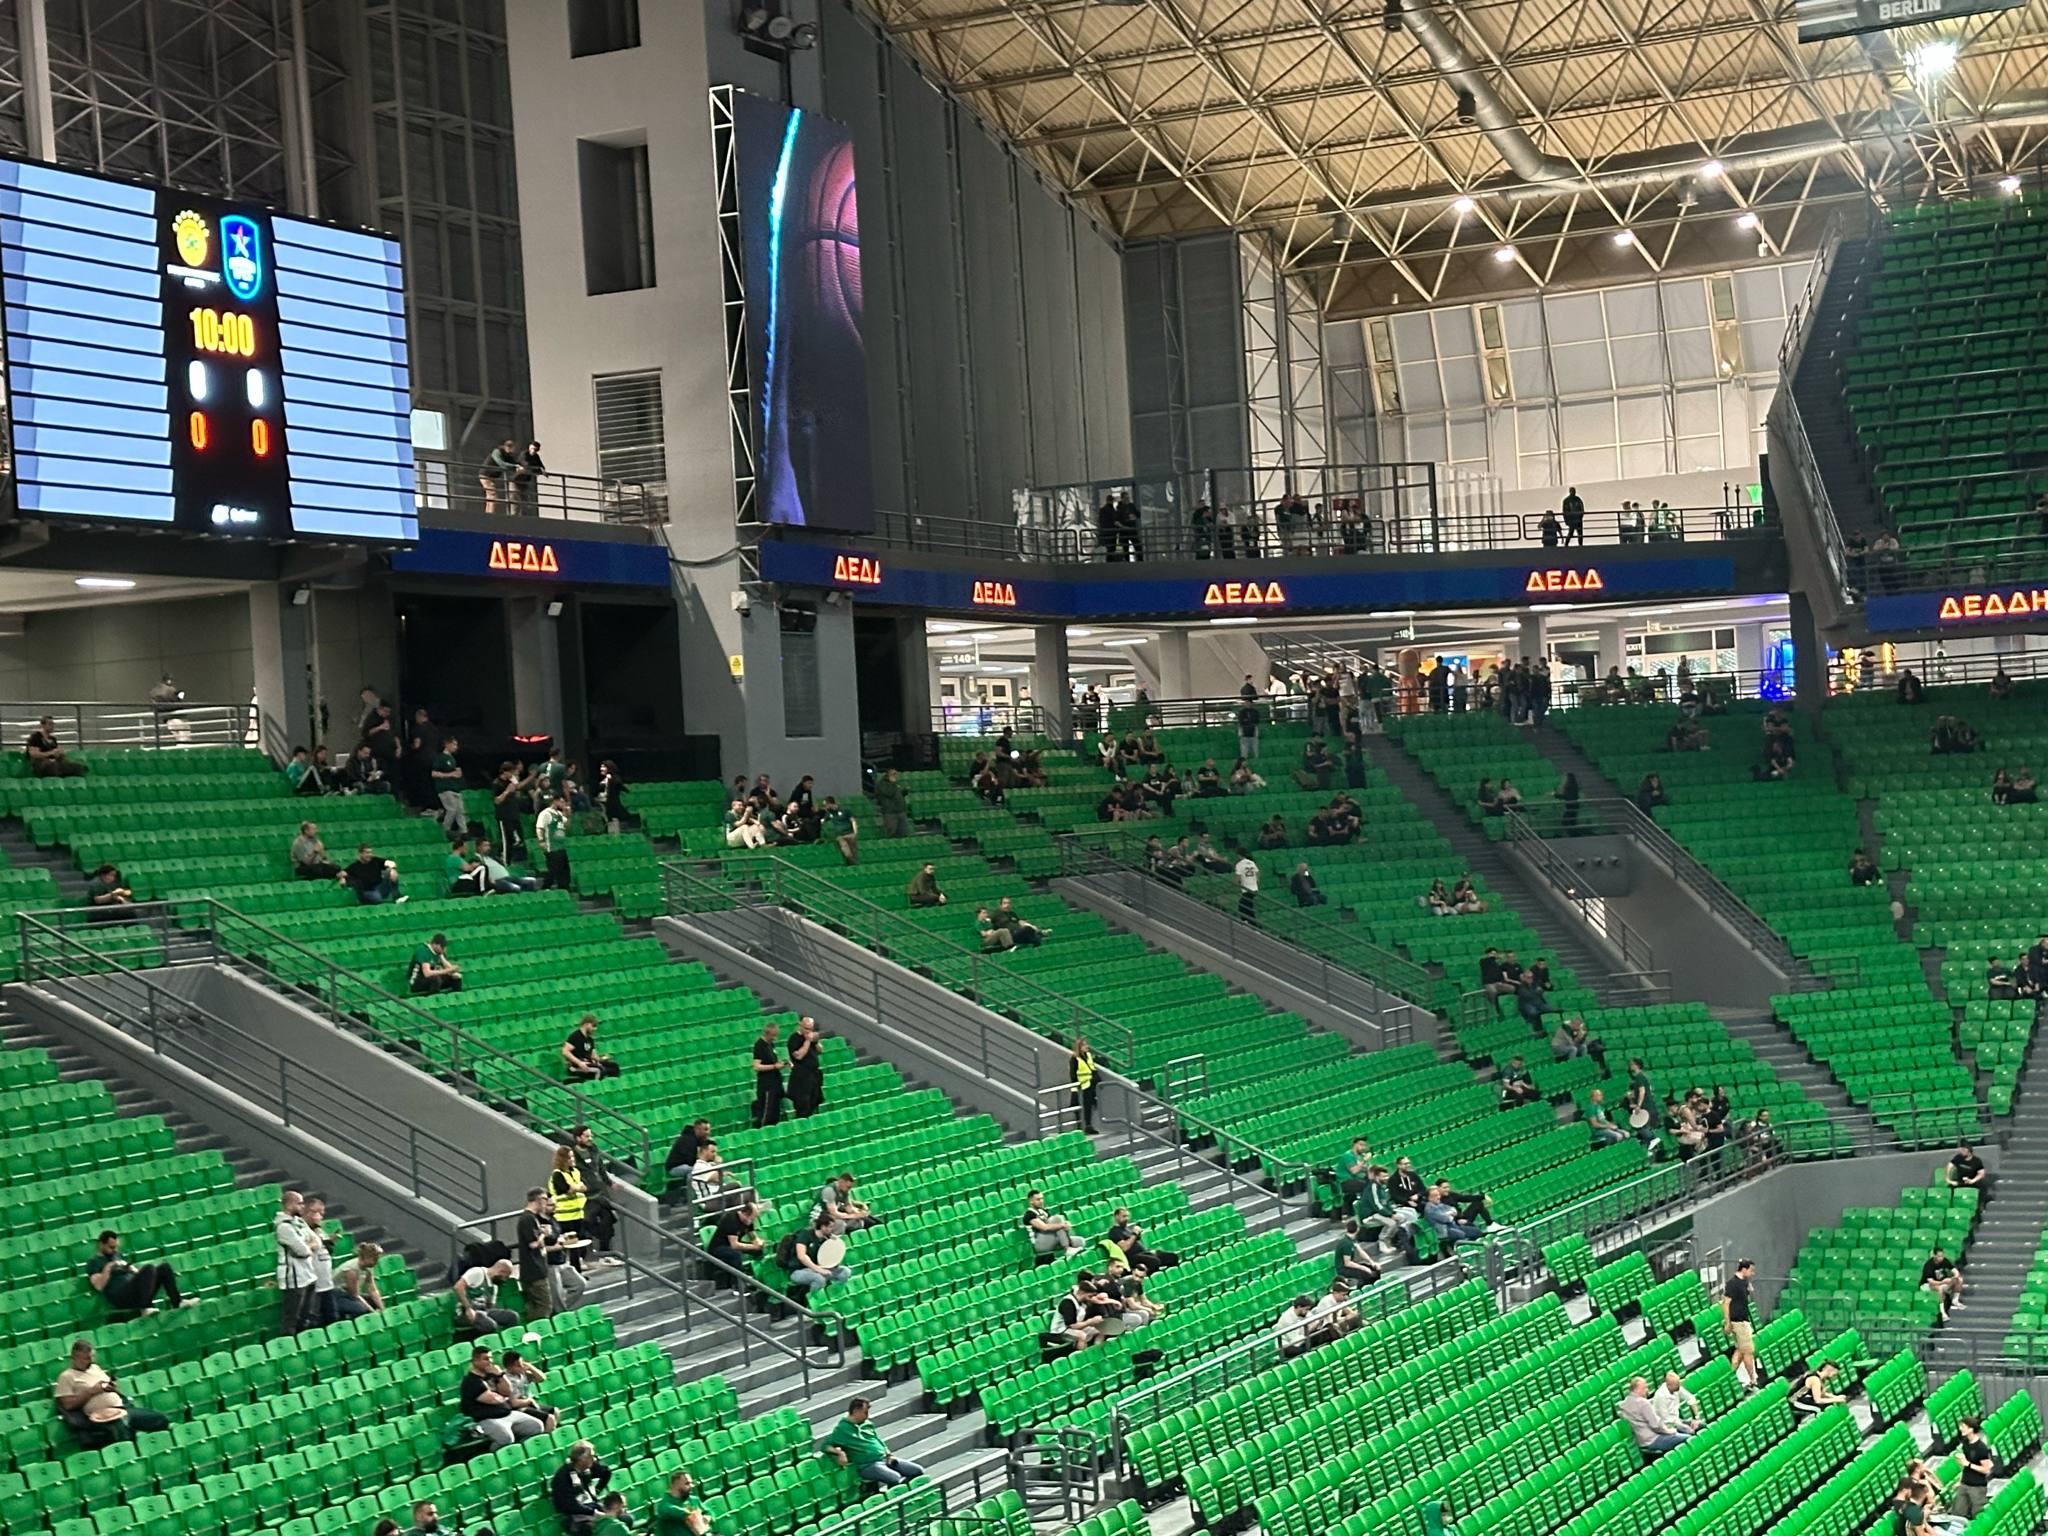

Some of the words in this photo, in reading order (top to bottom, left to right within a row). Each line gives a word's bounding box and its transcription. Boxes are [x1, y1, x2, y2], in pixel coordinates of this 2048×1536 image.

[1879, 0, 1942, 19] BERLIN
[190, 307, 255, 356] 10:00
[190, 411, 207, 448] 0
[252, 418, 269, 455] 0
[489, 541, 559, 572] ΔΕΔΔ
[1525, 568, 1603, 592] ΔΕΔΔ
[973, 581, 1016, 606] ΔΕΔΔ
[1204, 582, 1286, 605] ΔΕΔΔ
